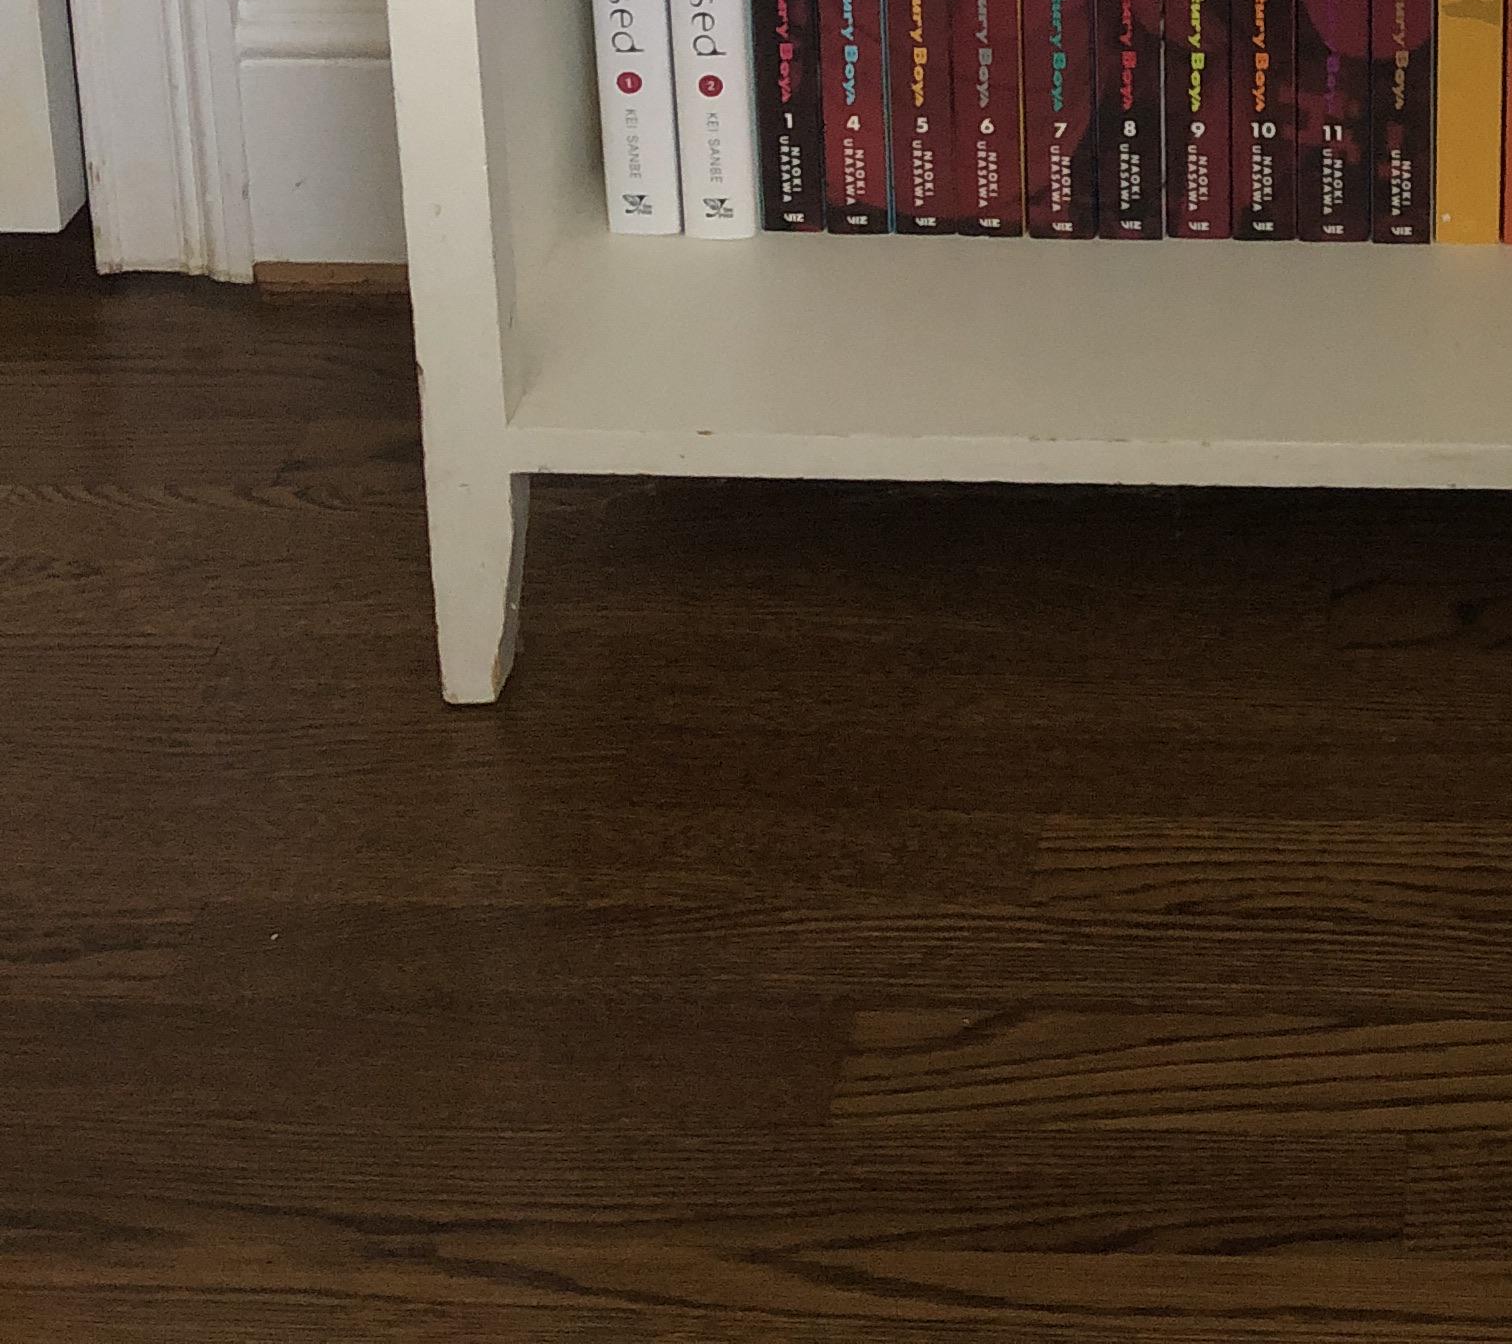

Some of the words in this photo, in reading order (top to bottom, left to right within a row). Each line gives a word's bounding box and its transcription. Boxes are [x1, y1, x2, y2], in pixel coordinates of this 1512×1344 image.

[843, 45, 859, 105] Boys
[1189, 53, 1205, 112] Boys
[625, 109, 638, 129] KEI
[847, 116, 861, 131] 4
[1191, 122, 1205, 138] 9
[1251, 123, 1276, 138] 10
[627, 135, 641, 178] SANBE
[844, 139, 855, 205] URASAWA
[855, 150, 865, 195] NAOKI
